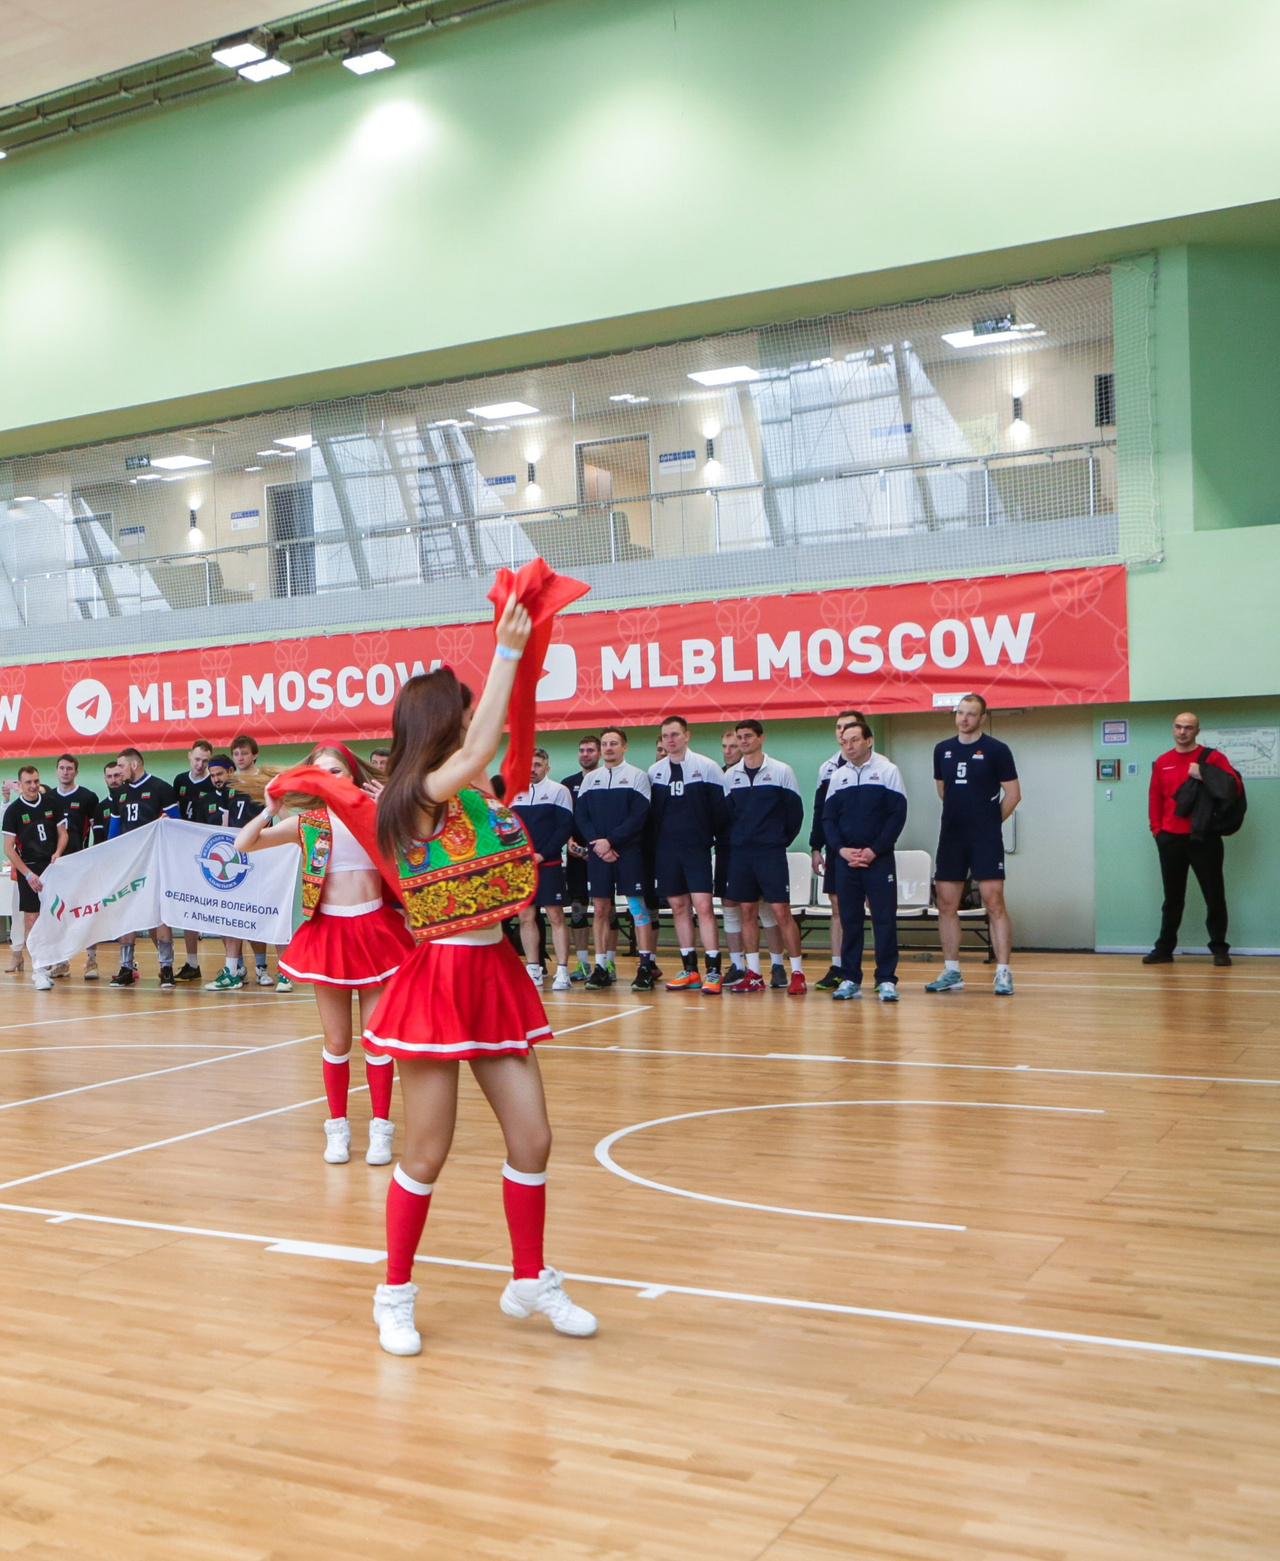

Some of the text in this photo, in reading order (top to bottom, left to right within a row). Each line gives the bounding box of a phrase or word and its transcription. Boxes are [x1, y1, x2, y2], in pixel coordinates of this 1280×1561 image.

[601, 612, 1035, 691] MLBLMOSCOW
[956, 762, 967, 778] 5
[669, 781, 685, 797] 19
[126, 803, 139, 822] 13
[186, 801, 193, 819] 4
[237, 801, 245, 820] 7
[37, 823, 47, 841] 8
[165, 890, 279, 916] ФЕДЕРАЦИЯ ВОЛЕЙБОЛА
[184, 911, 257, 930] г. АЛЬМЕТЬЕВСК
